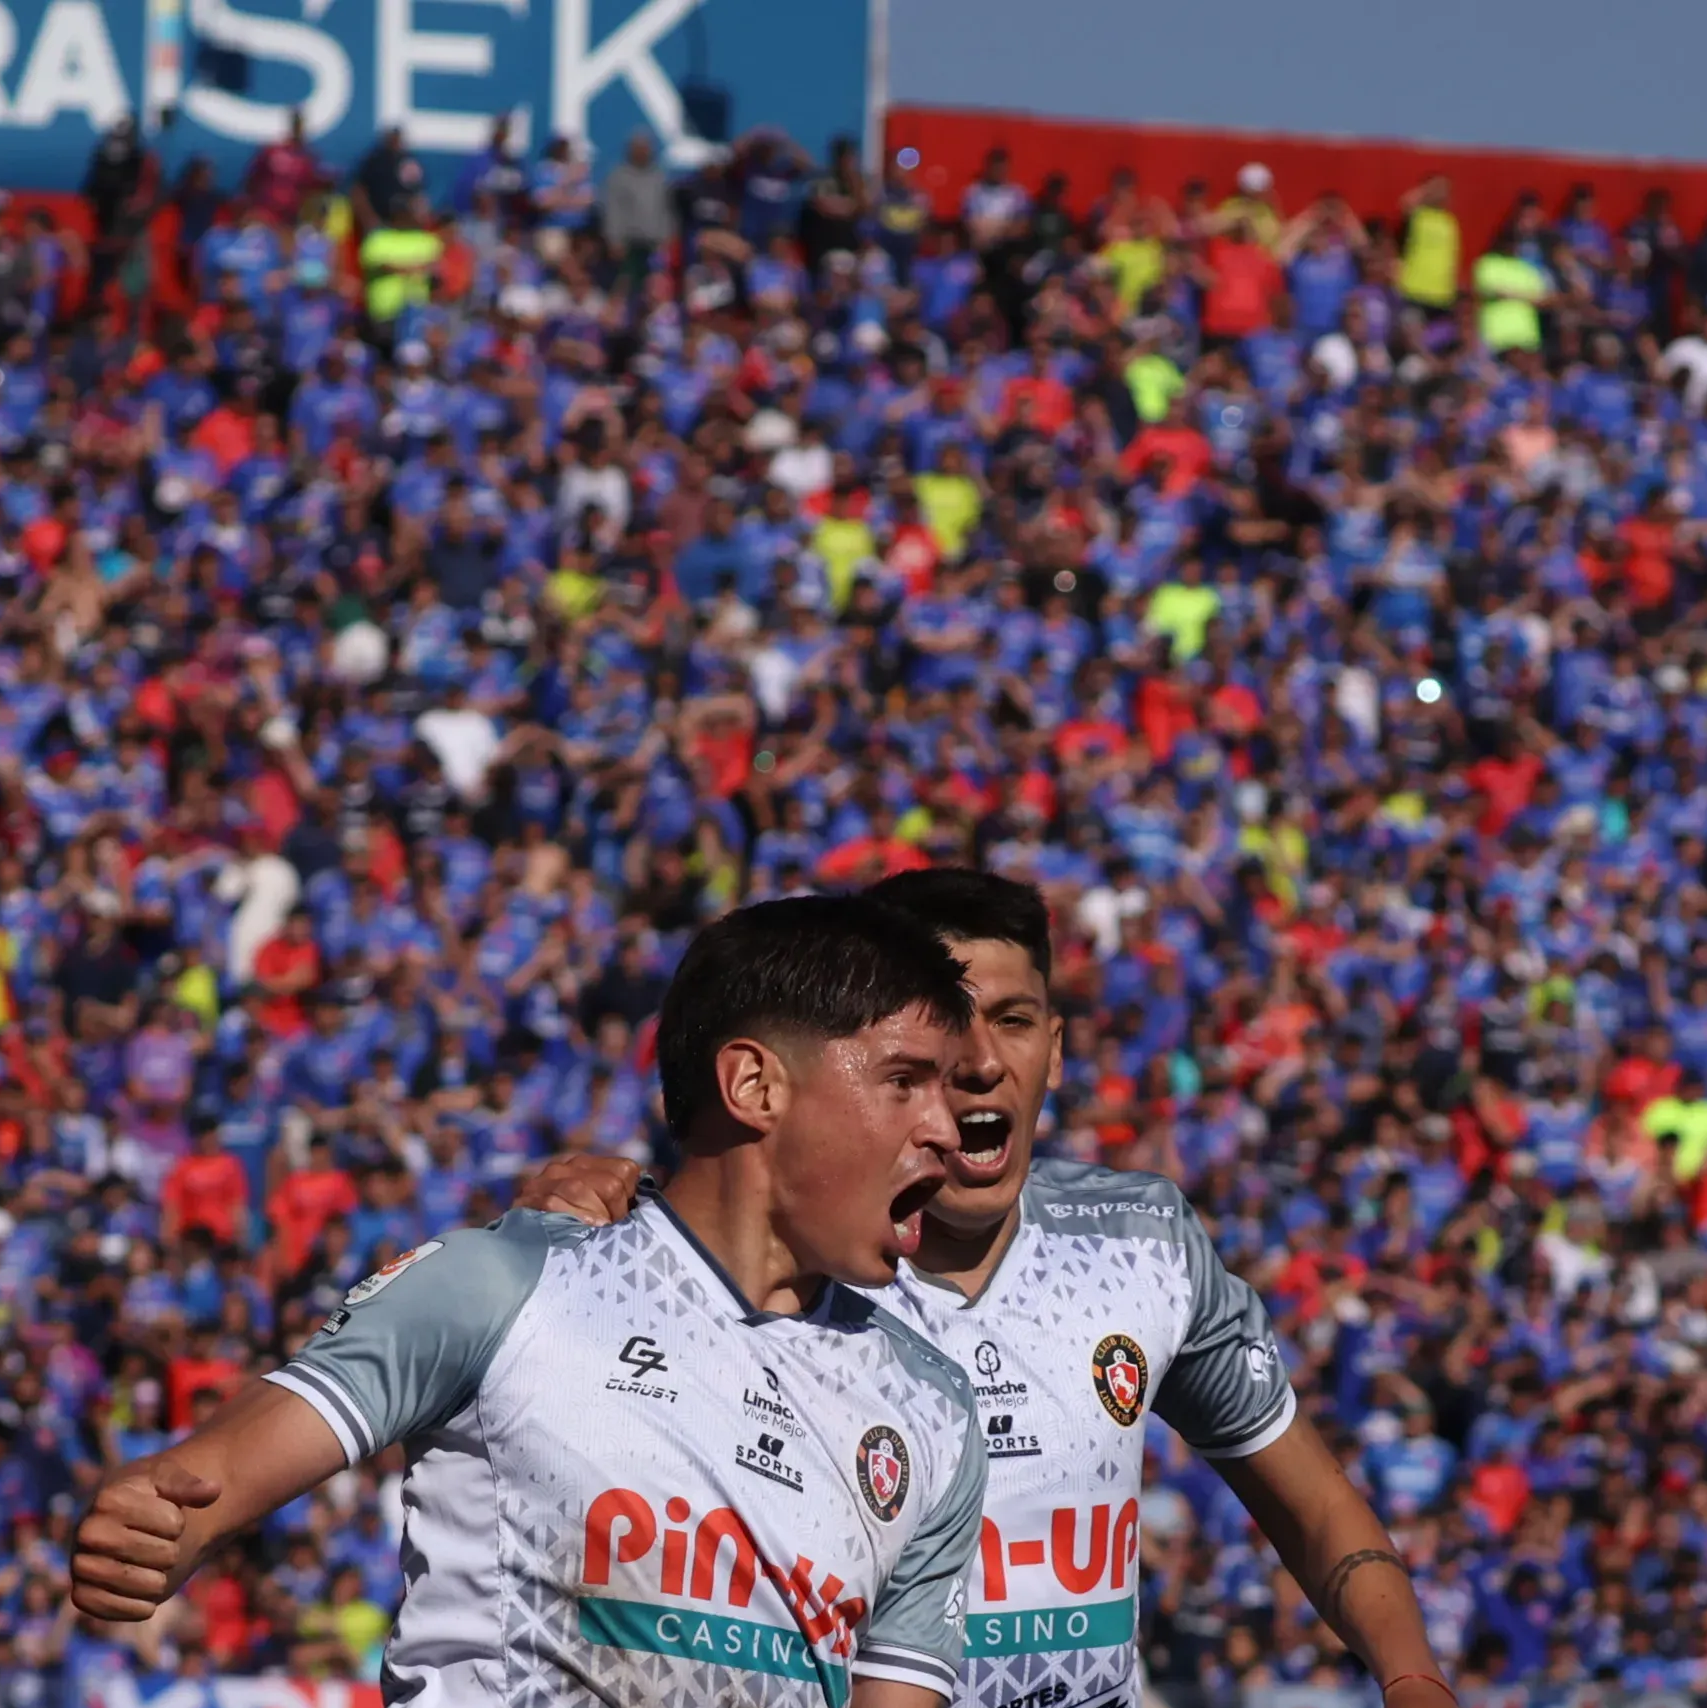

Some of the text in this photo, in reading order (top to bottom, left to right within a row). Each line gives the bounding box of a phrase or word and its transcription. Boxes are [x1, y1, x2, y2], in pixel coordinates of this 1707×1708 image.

[1076, 1202, 1175, 1218] RIVECAR
[743, 1404, 769, 1424] Vive
[865, 1427, 888, 1444] CLUB
[736, 1444, 804, 1483] SPORTS
